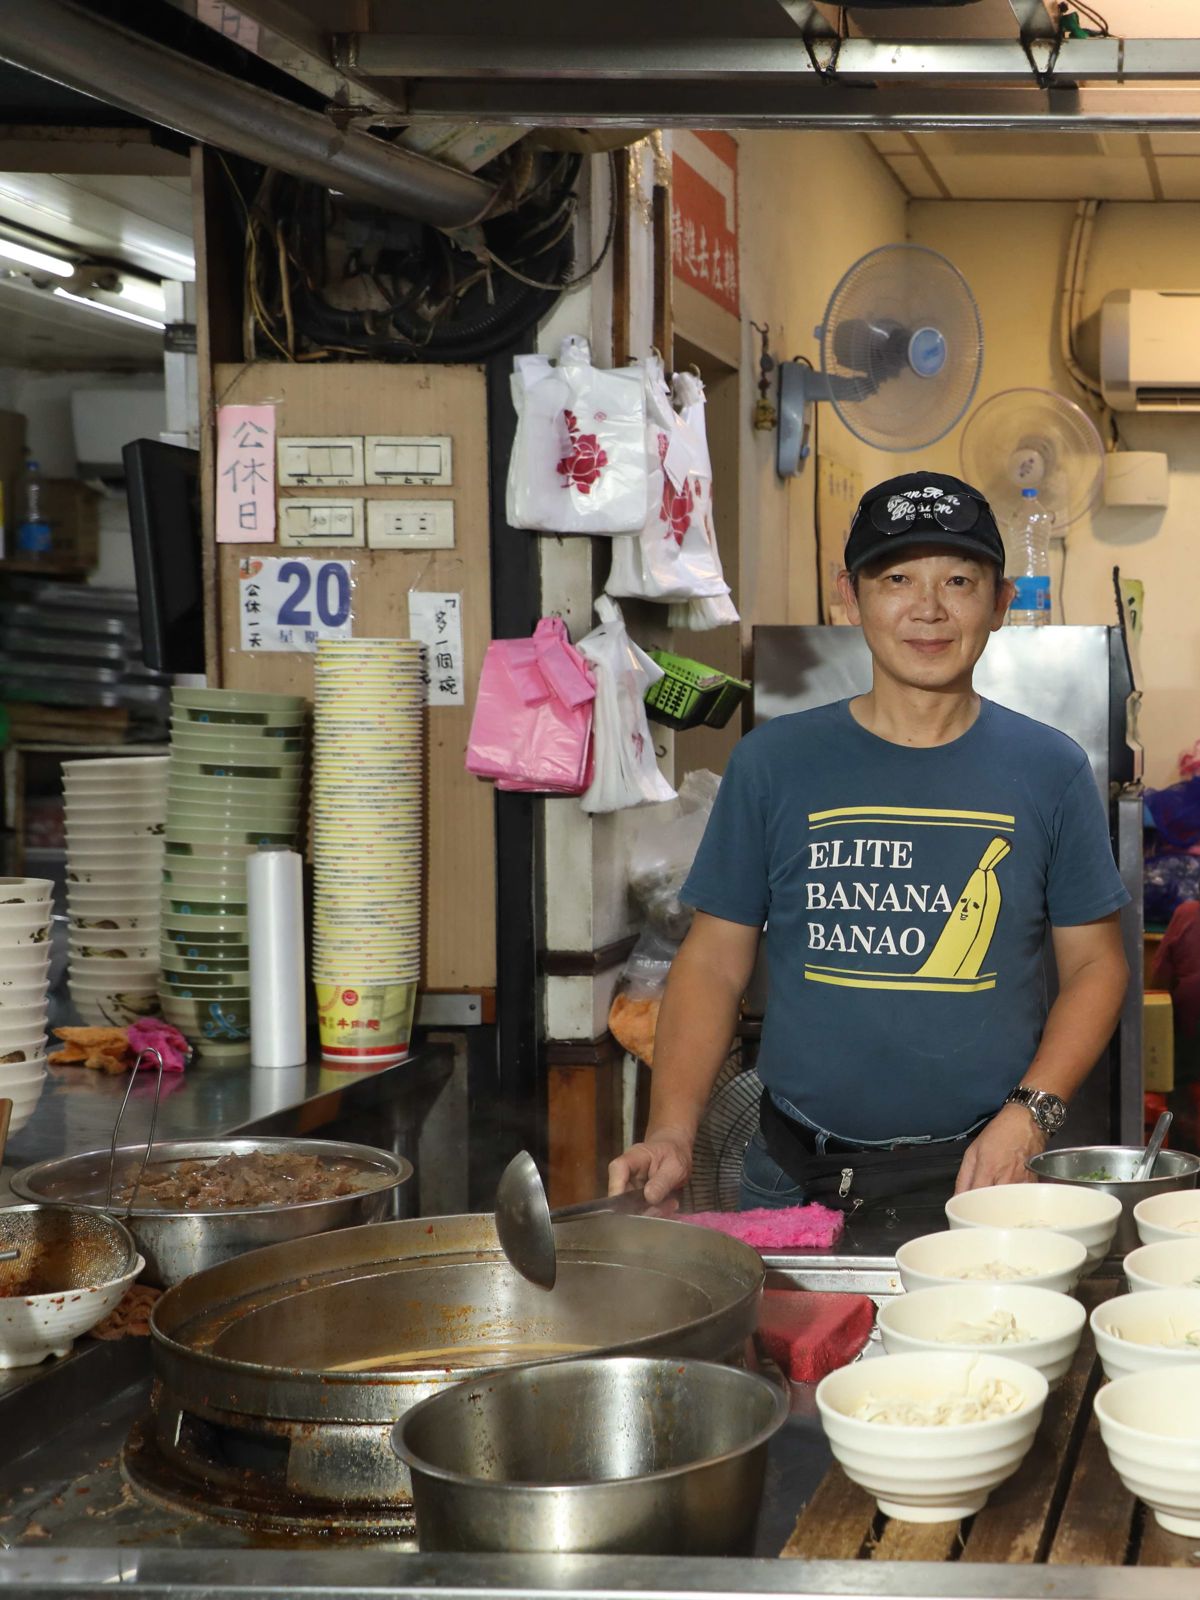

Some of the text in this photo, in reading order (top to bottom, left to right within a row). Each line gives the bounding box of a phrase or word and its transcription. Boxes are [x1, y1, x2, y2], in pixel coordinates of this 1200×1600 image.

[222, 420, 269, 531] 公休日
[244, 584, 263, 648] 公休一天
[277, 561, 351, 628] 20
[807, 839, 913, 870] ELITE
[805, 881, 953, 913] BANANA
[807, 922, 926, 956] BANAO
